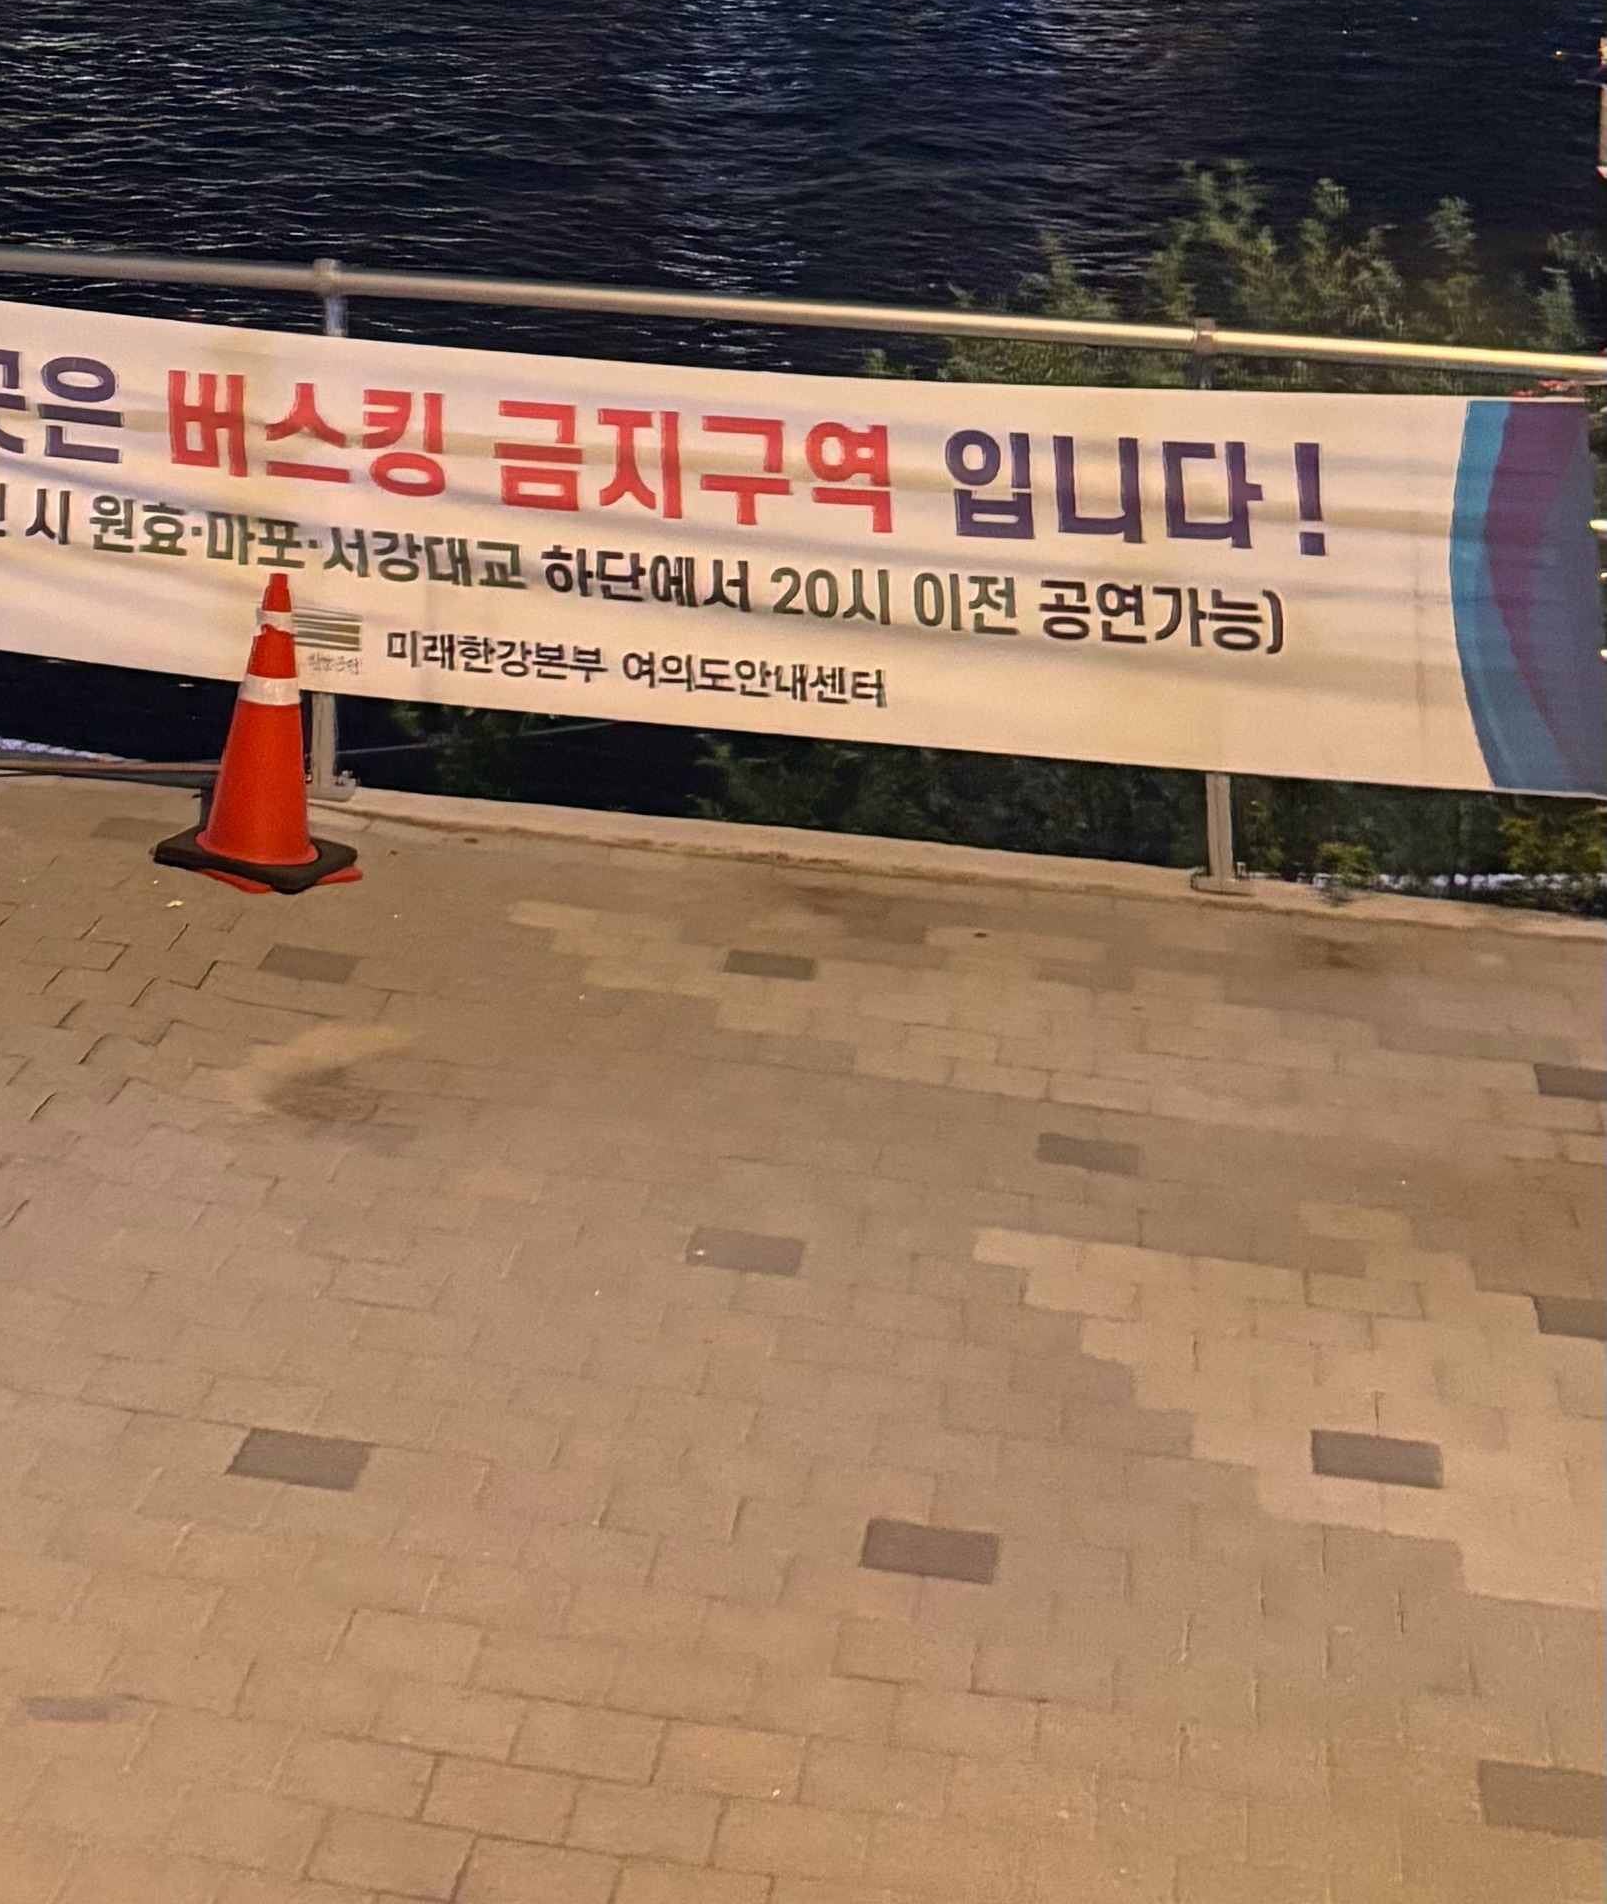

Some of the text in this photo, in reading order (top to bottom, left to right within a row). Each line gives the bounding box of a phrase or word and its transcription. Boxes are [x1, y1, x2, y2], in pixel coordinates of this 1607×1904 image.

[168, 370, 446, 497] 버스킹
[493, 400, 893, 533] 금지구역
[945, 430, 1326, 556] 입니다!
[25, 487, 71, 545] 시
[540, 544, 752, 614] 하단에서
[770, 566, 892, 627] 20시
[912, 572, 1020, 636] 이전
[1039, 578, 1283, 655] 공연가능)
[387, 630, 608, 683] 미래한강본부
[622, 651, 888, 708] 여의도안내센터
